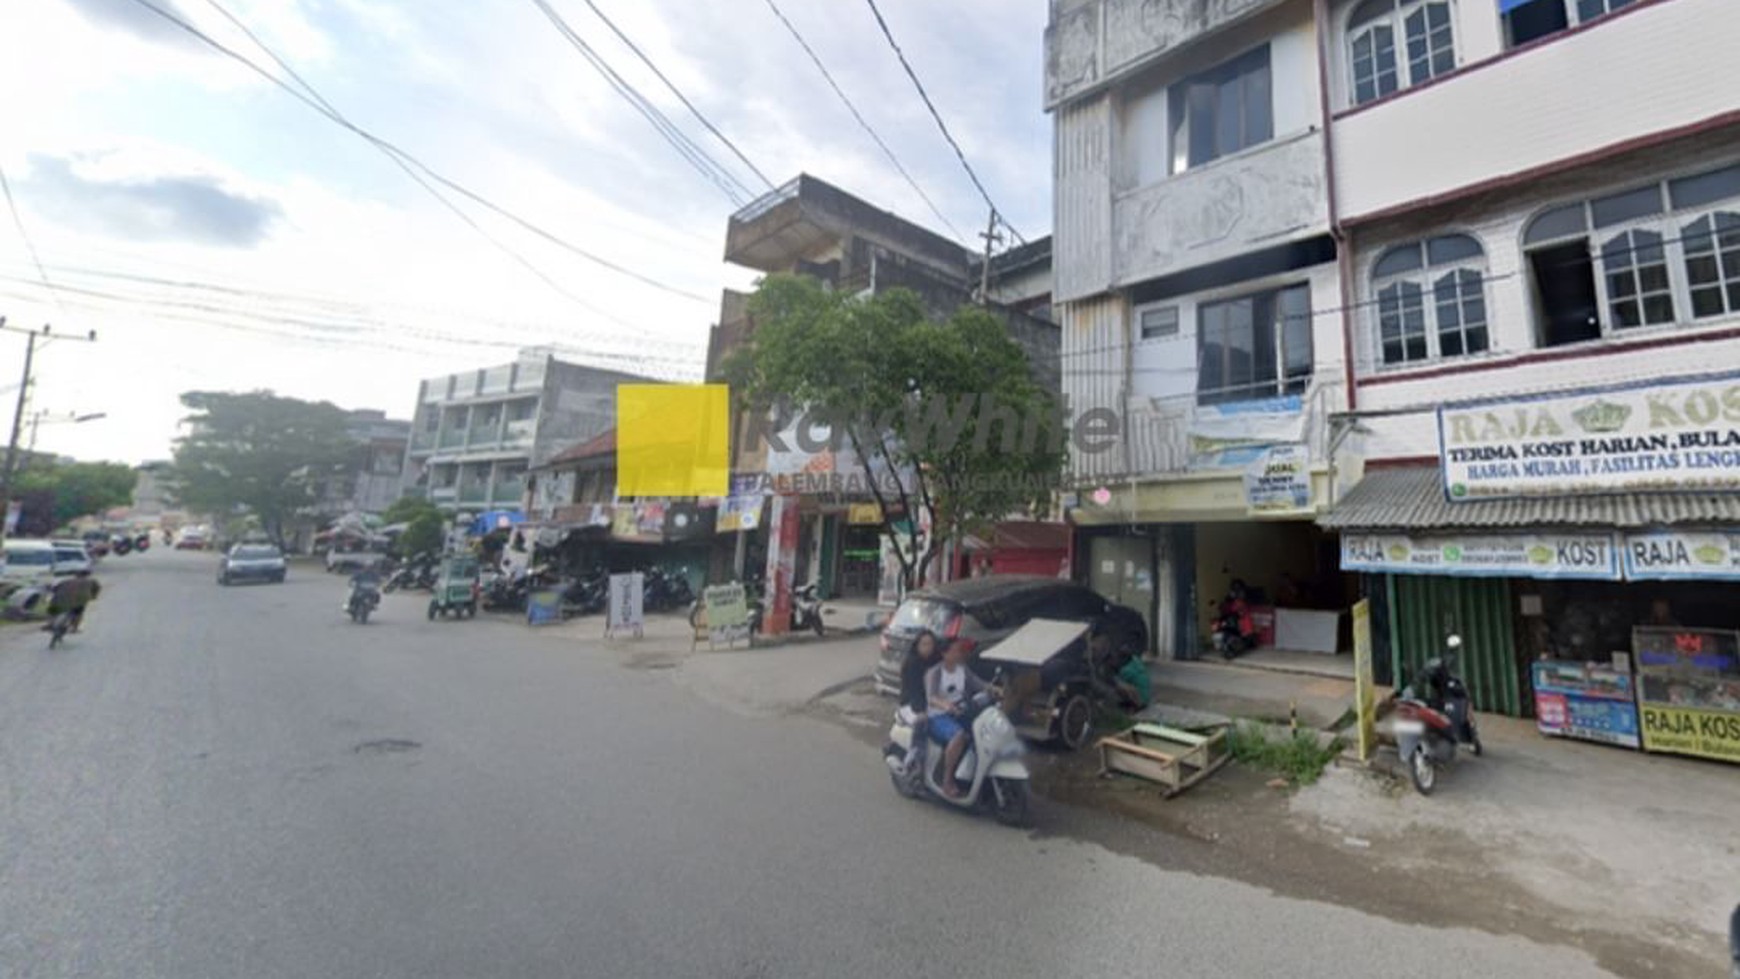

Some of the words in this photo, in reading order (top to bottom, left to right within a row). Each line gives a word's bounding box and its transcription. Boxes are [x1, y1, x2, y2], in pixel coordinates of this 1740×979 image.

[1449, 405, 1563, 443] RAJA
[1647, 387, 1740, 428] KOS
[1449, 447, 1517, 463] TERIMA
[1521, 442, 1575, 458] KOST
[1678, 430, 1740, 448] BULA
[1467, 464, 1520, 480] HARGA
[1590, 454, 1680, 475] FASILITAS
[1348, 539, 1385, 562] RAJA
[1555, 540, 1606, 566] KOST
[1633, 540, 1690, 567] RAJA
[1643, 710, 1697, 736] RAJA
[1698, 714, 1740, 742] KOS
